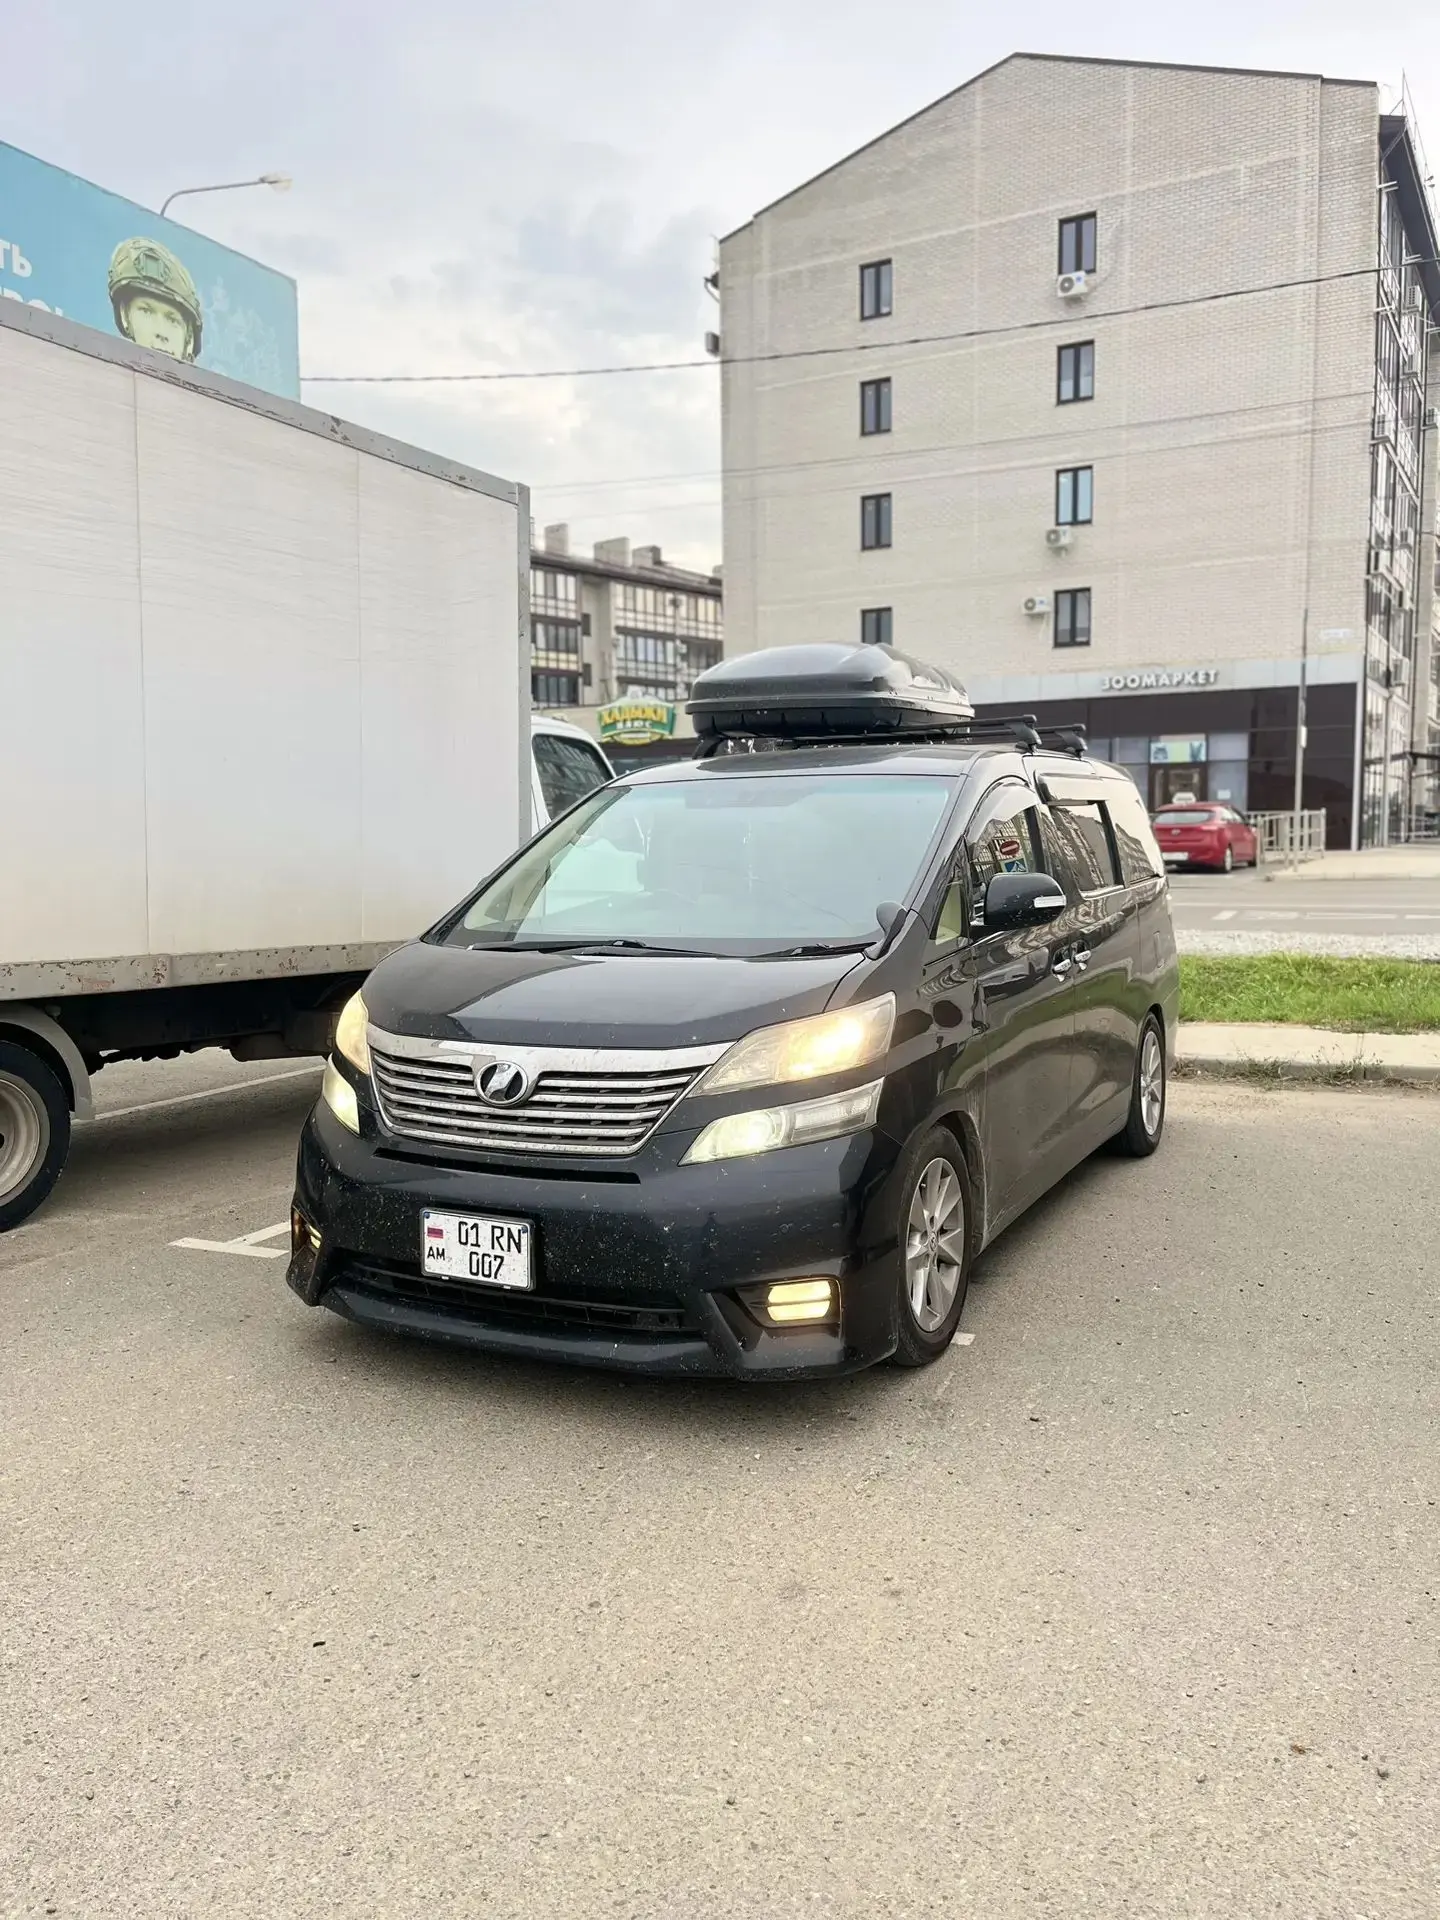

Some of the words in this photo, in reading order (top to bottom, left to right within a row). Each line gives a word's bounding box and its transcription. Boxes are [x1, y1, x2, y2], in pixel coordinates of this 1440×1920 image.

[1102, 669, 1218, 690] ЗООМАРКЕТ
[457, 1220, 481, 1248] 01
[491, 1225, 522, 1254] RN
[427, 1246, 446, 1261] AM
[468, 1251, 504, 1279] 007
